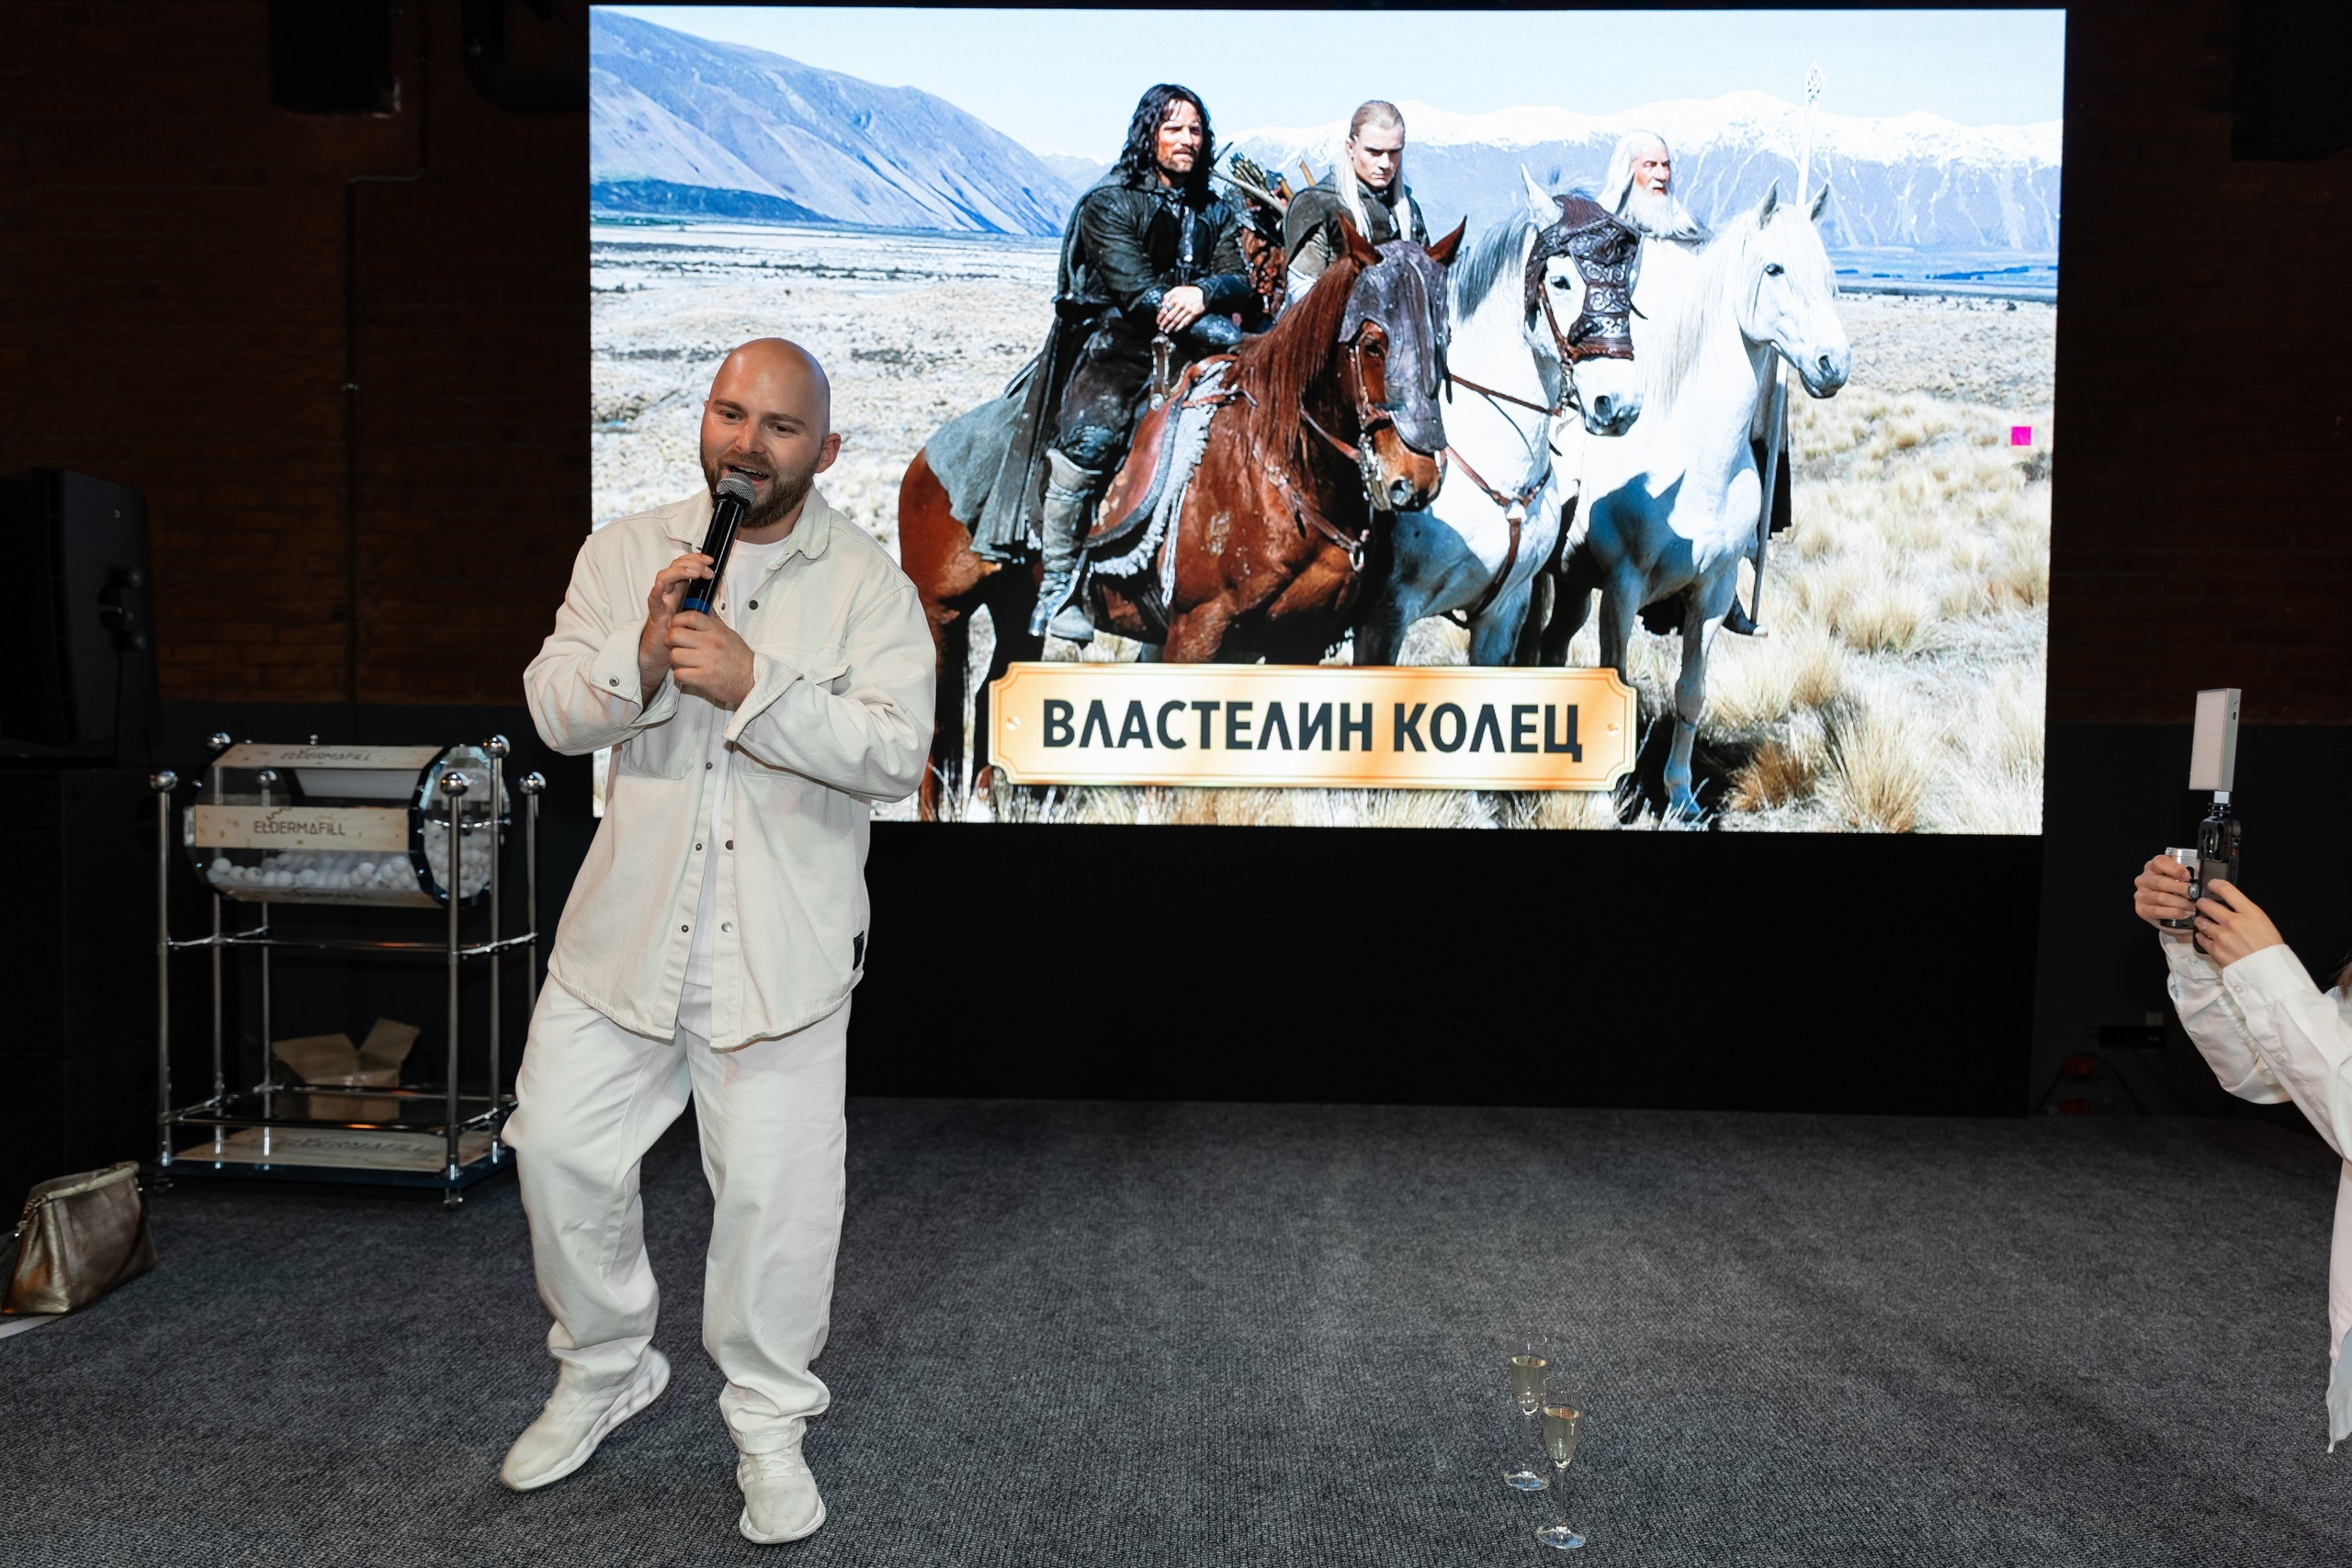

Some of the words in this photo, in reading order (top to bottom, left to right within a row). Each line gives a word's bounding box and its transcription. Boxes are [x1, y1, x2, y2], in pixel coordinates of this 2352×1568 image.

[1043, 698, 1373, 752] ВЛАСТЕЛИН
[1393, 702, 1582, 762] КОЛЕЦ
[254, 820, 346, 836] ELDERMAFILL
